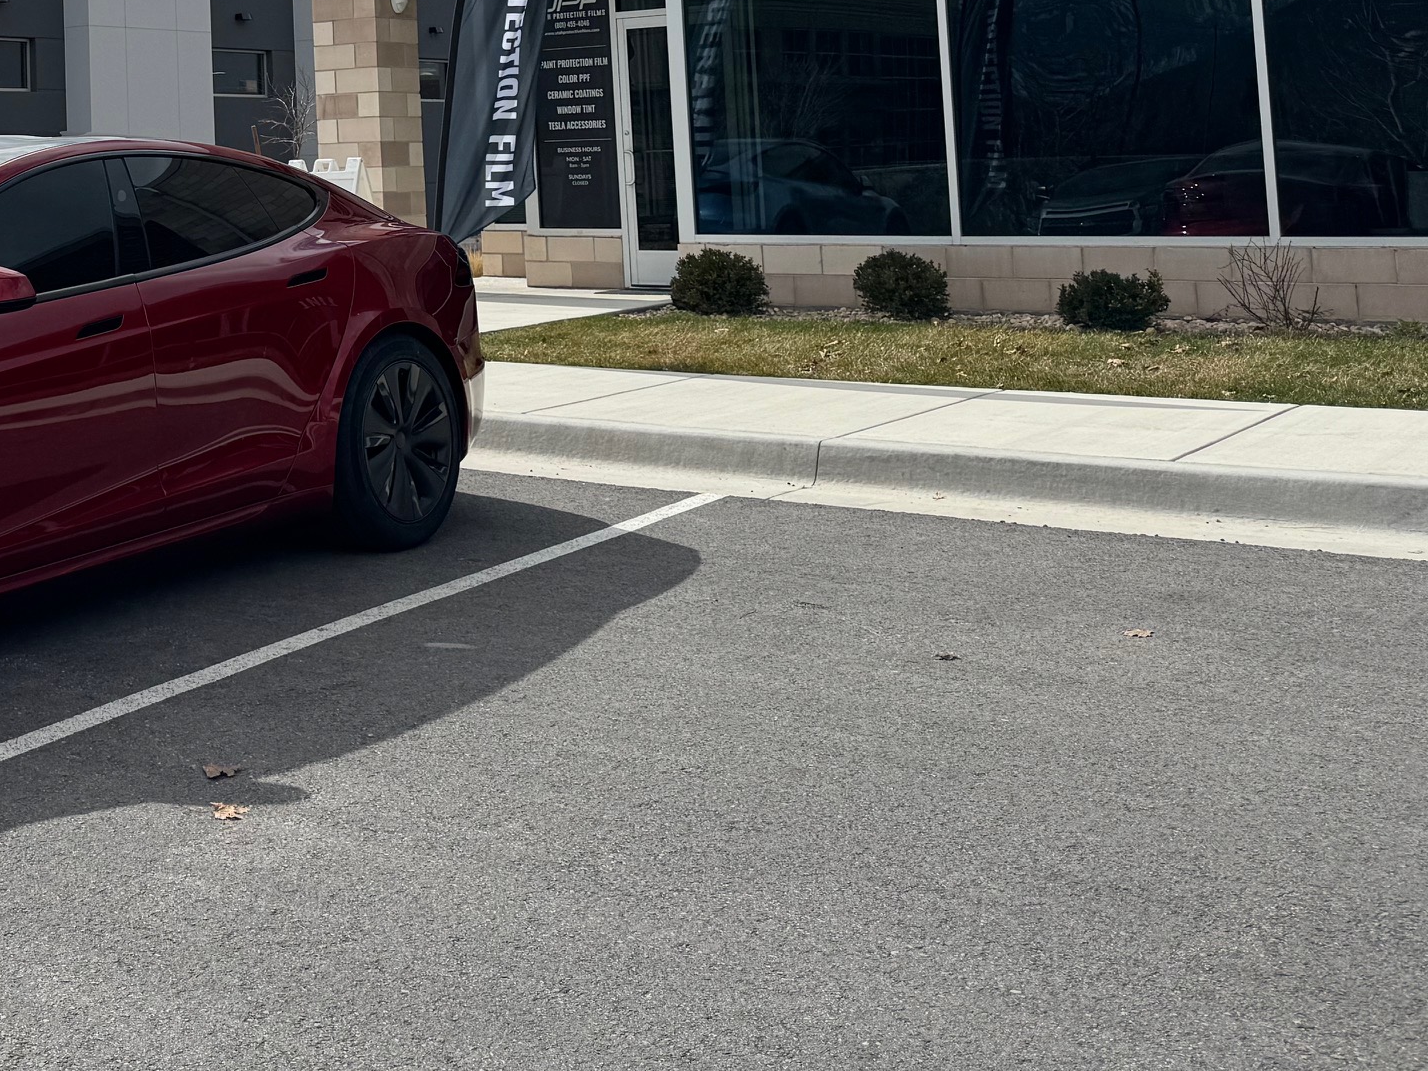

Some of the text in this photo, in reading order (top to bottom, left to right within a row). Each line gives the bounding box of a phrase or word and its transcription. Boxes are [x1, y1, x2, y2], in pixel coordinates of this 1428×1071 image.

[553, 10, 586, 20] PROTECTIVE
[588, 9, 606, 17] FILMS
[557, 58, 593, 68] PROTECTION
[594, 57, 608, 66] FILM
[558, 73, 591, 83] COLOR PPF
[547, 89, 604, 99] CERAMIC COATINGS
[557, 104, 595, 114] WINDOW TINT
[548, 120, 606, 130] TESLA ACCESSORIES
[484, 134, 517, 208] FILM
